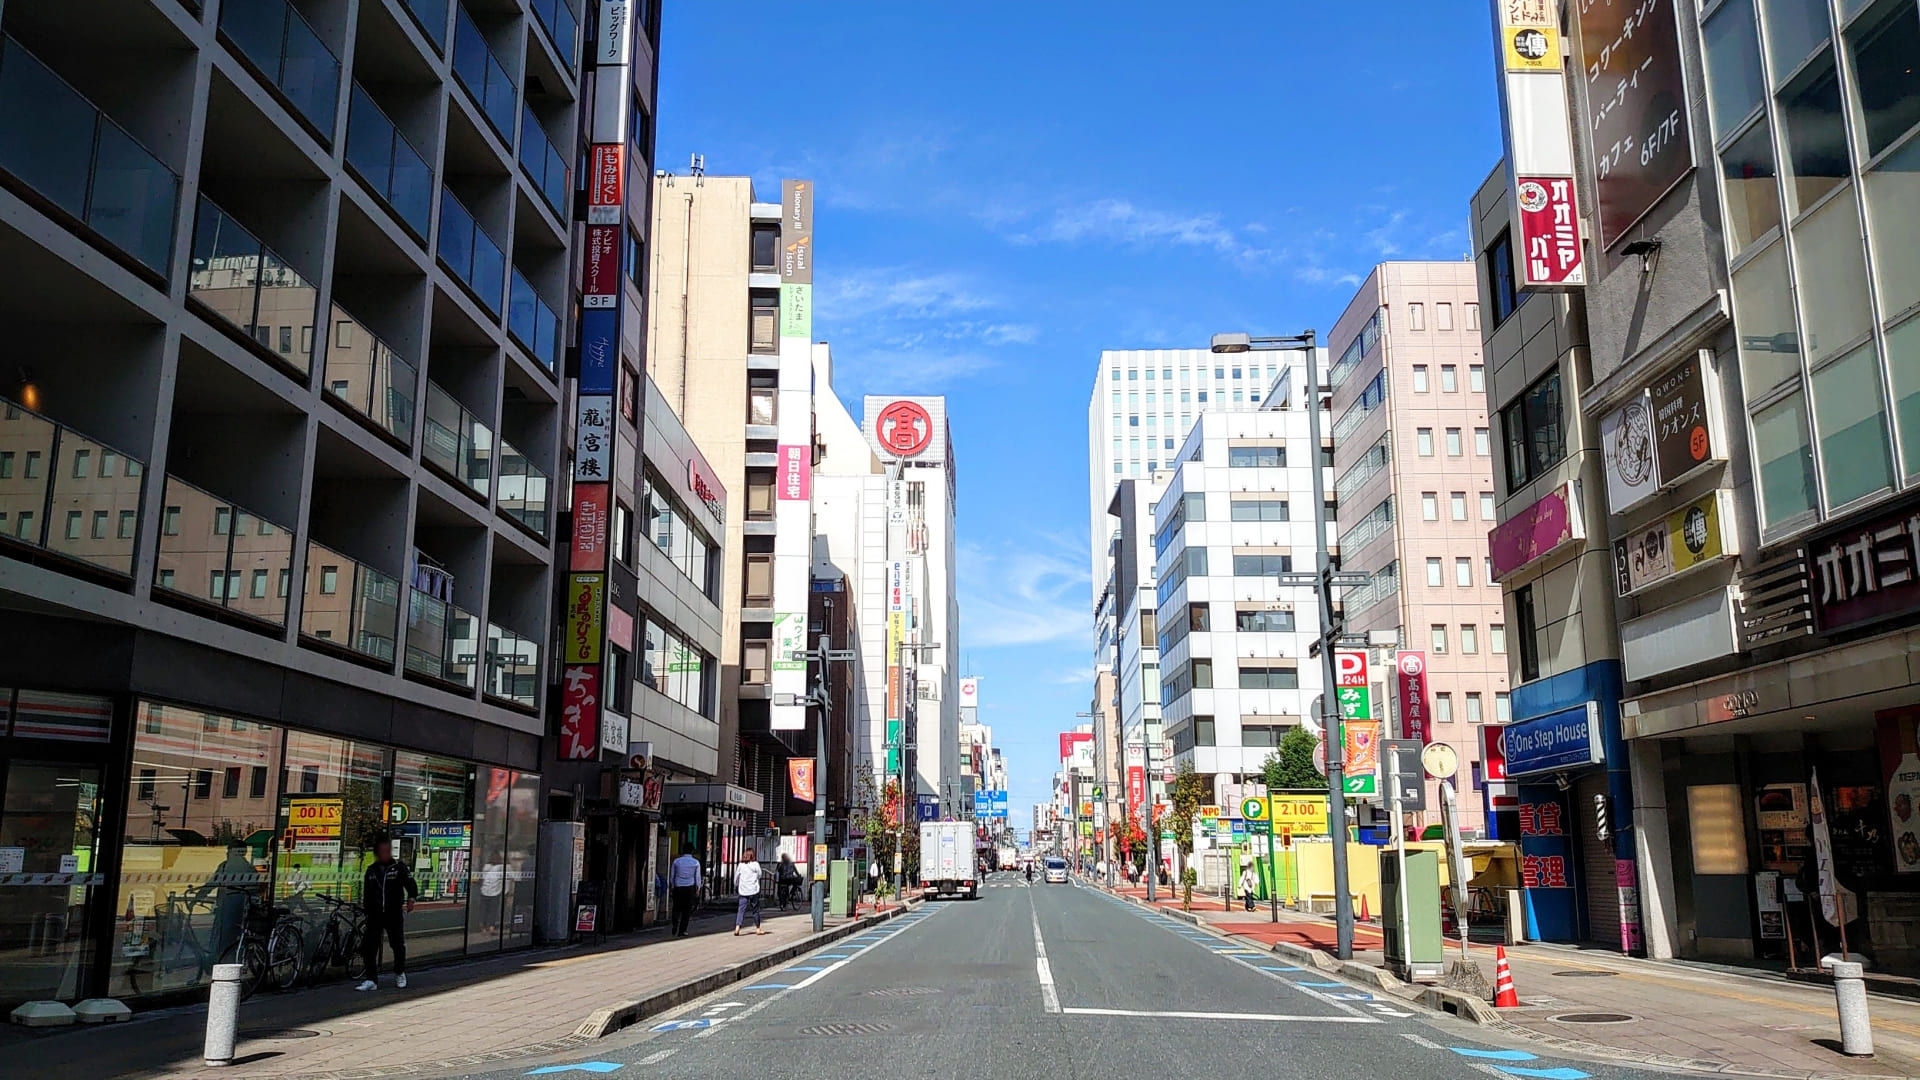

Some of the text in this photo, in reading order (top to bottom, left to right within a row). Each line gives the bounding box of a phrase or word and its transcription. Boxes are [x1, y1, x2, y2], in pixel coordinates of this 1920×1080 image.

[608, 6, 620, 58] ビッグワーク
[1594, 56, 1653, 130] パーティー
[1639, 110, 1680, 167] 6F/7F
[1600, 135, 1634, 181] カフェ
[603, 154, 618, 204] もみほぐし
[602, 228, 613, 254] ナビオ
[797, 236, 809, 270] Visual
[1531, 234, 1552, 281] バル
[785, 243, 798, 277] Vision
[590, 296, 609, 306] 3F
[794, 286, 805, 321] さいたま
[1655, 367, 1691, 397] QWONS
[1661, 401, 1701, 442] クオンズ
[1693, 434, 1705, 452] 5F
[1337, 655, 1362, 684] P
[1344, 676, 1365, 685] 24H
[1515, 721, 1588, 752] One Step House
[1202, 807, 1220, 817] NPC
[1249, 801, 1260, 817] P
[1519, 802, 1563, 835] 賃貸
[1522, 854, 1567, 887] 管理
